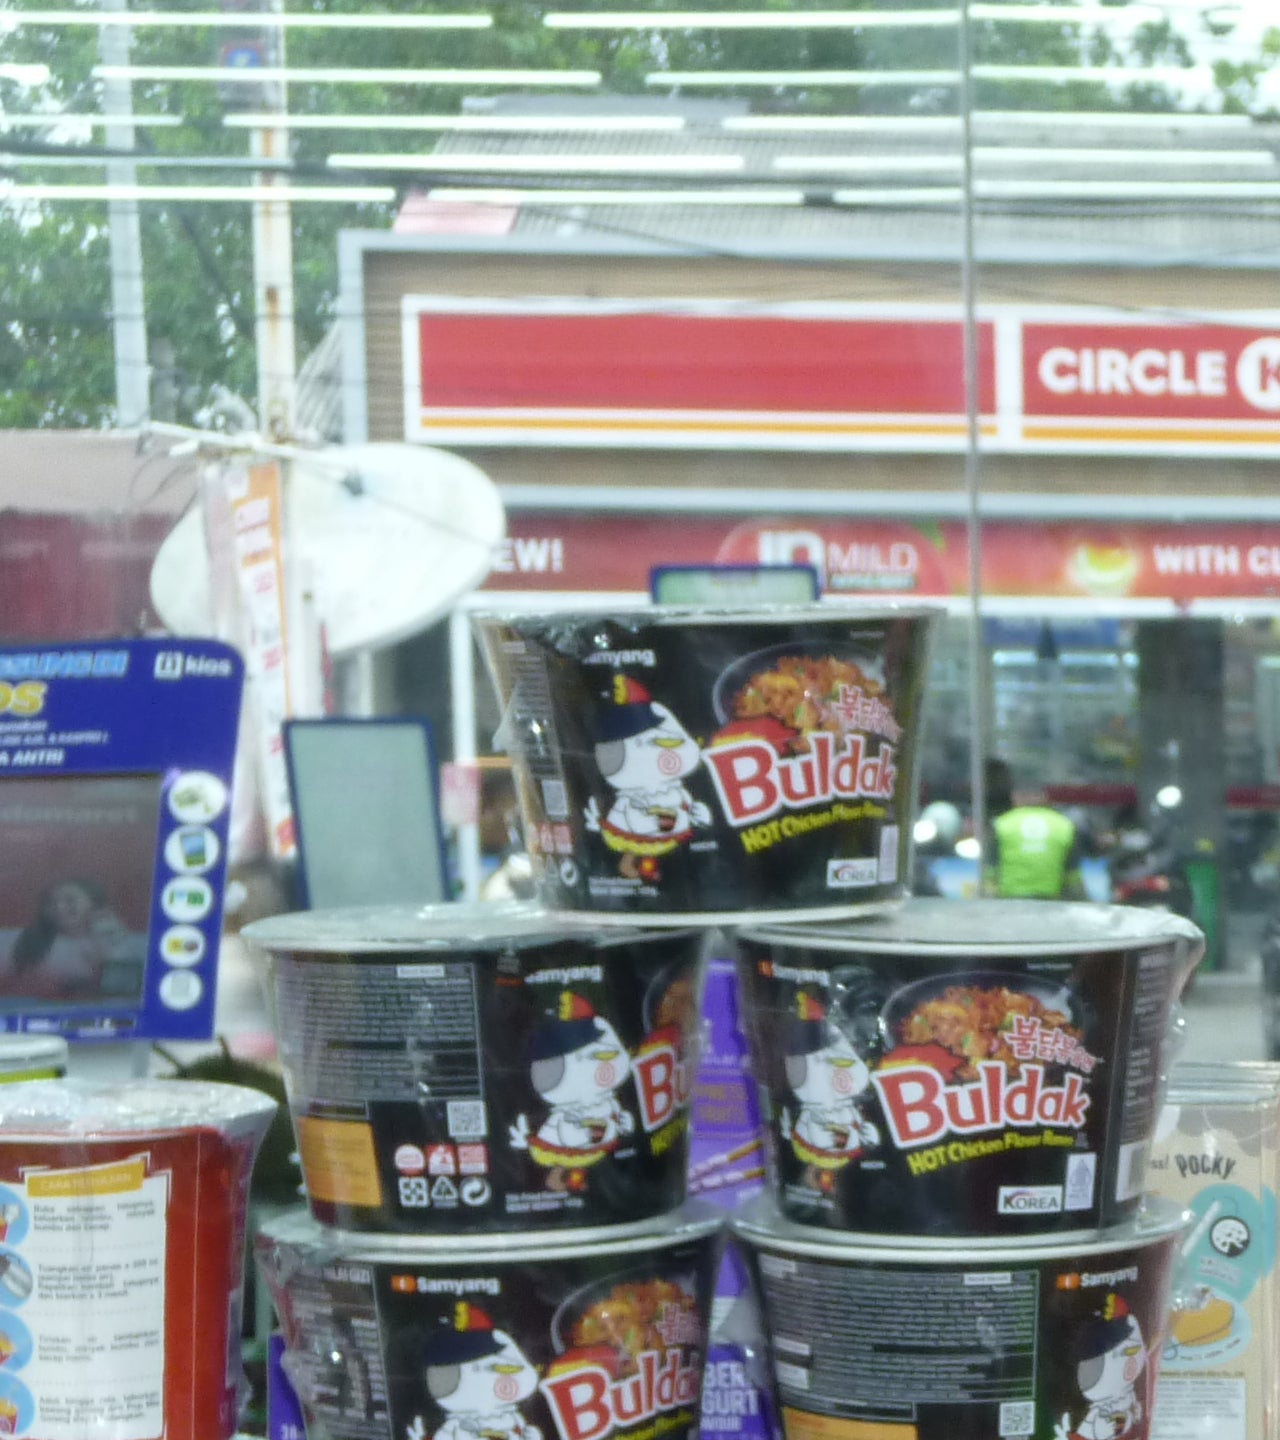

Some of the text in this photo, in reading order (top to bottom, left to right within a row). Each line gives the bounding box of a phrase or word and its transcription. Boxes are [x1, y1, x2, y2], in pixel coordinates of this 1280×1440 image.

[1038, 348, 1227, 396] CIRCLE
[495, 538, 562, 572] EW!
[829, 543, 917, 572] MILD
[1153, 545, 1239, 576] WITH
[583, 648, 655, 666] amyang
[704, 732, 896, 826] Buldak
[740, 819, 785, 853] HOT
[874, 1061, 1091, 1147] Buldak
[907, 1146, 948, 1176] HOT
[949, 1136, 1002, 1163] Chicken
[1174, 1153, 1237, 1180] POCKY
[1003, 1194, 1059, 1210] KOREA
[417, 1277, 499, 1295] Samyang
[1080, 1266, 1138, 1289] Samyang
